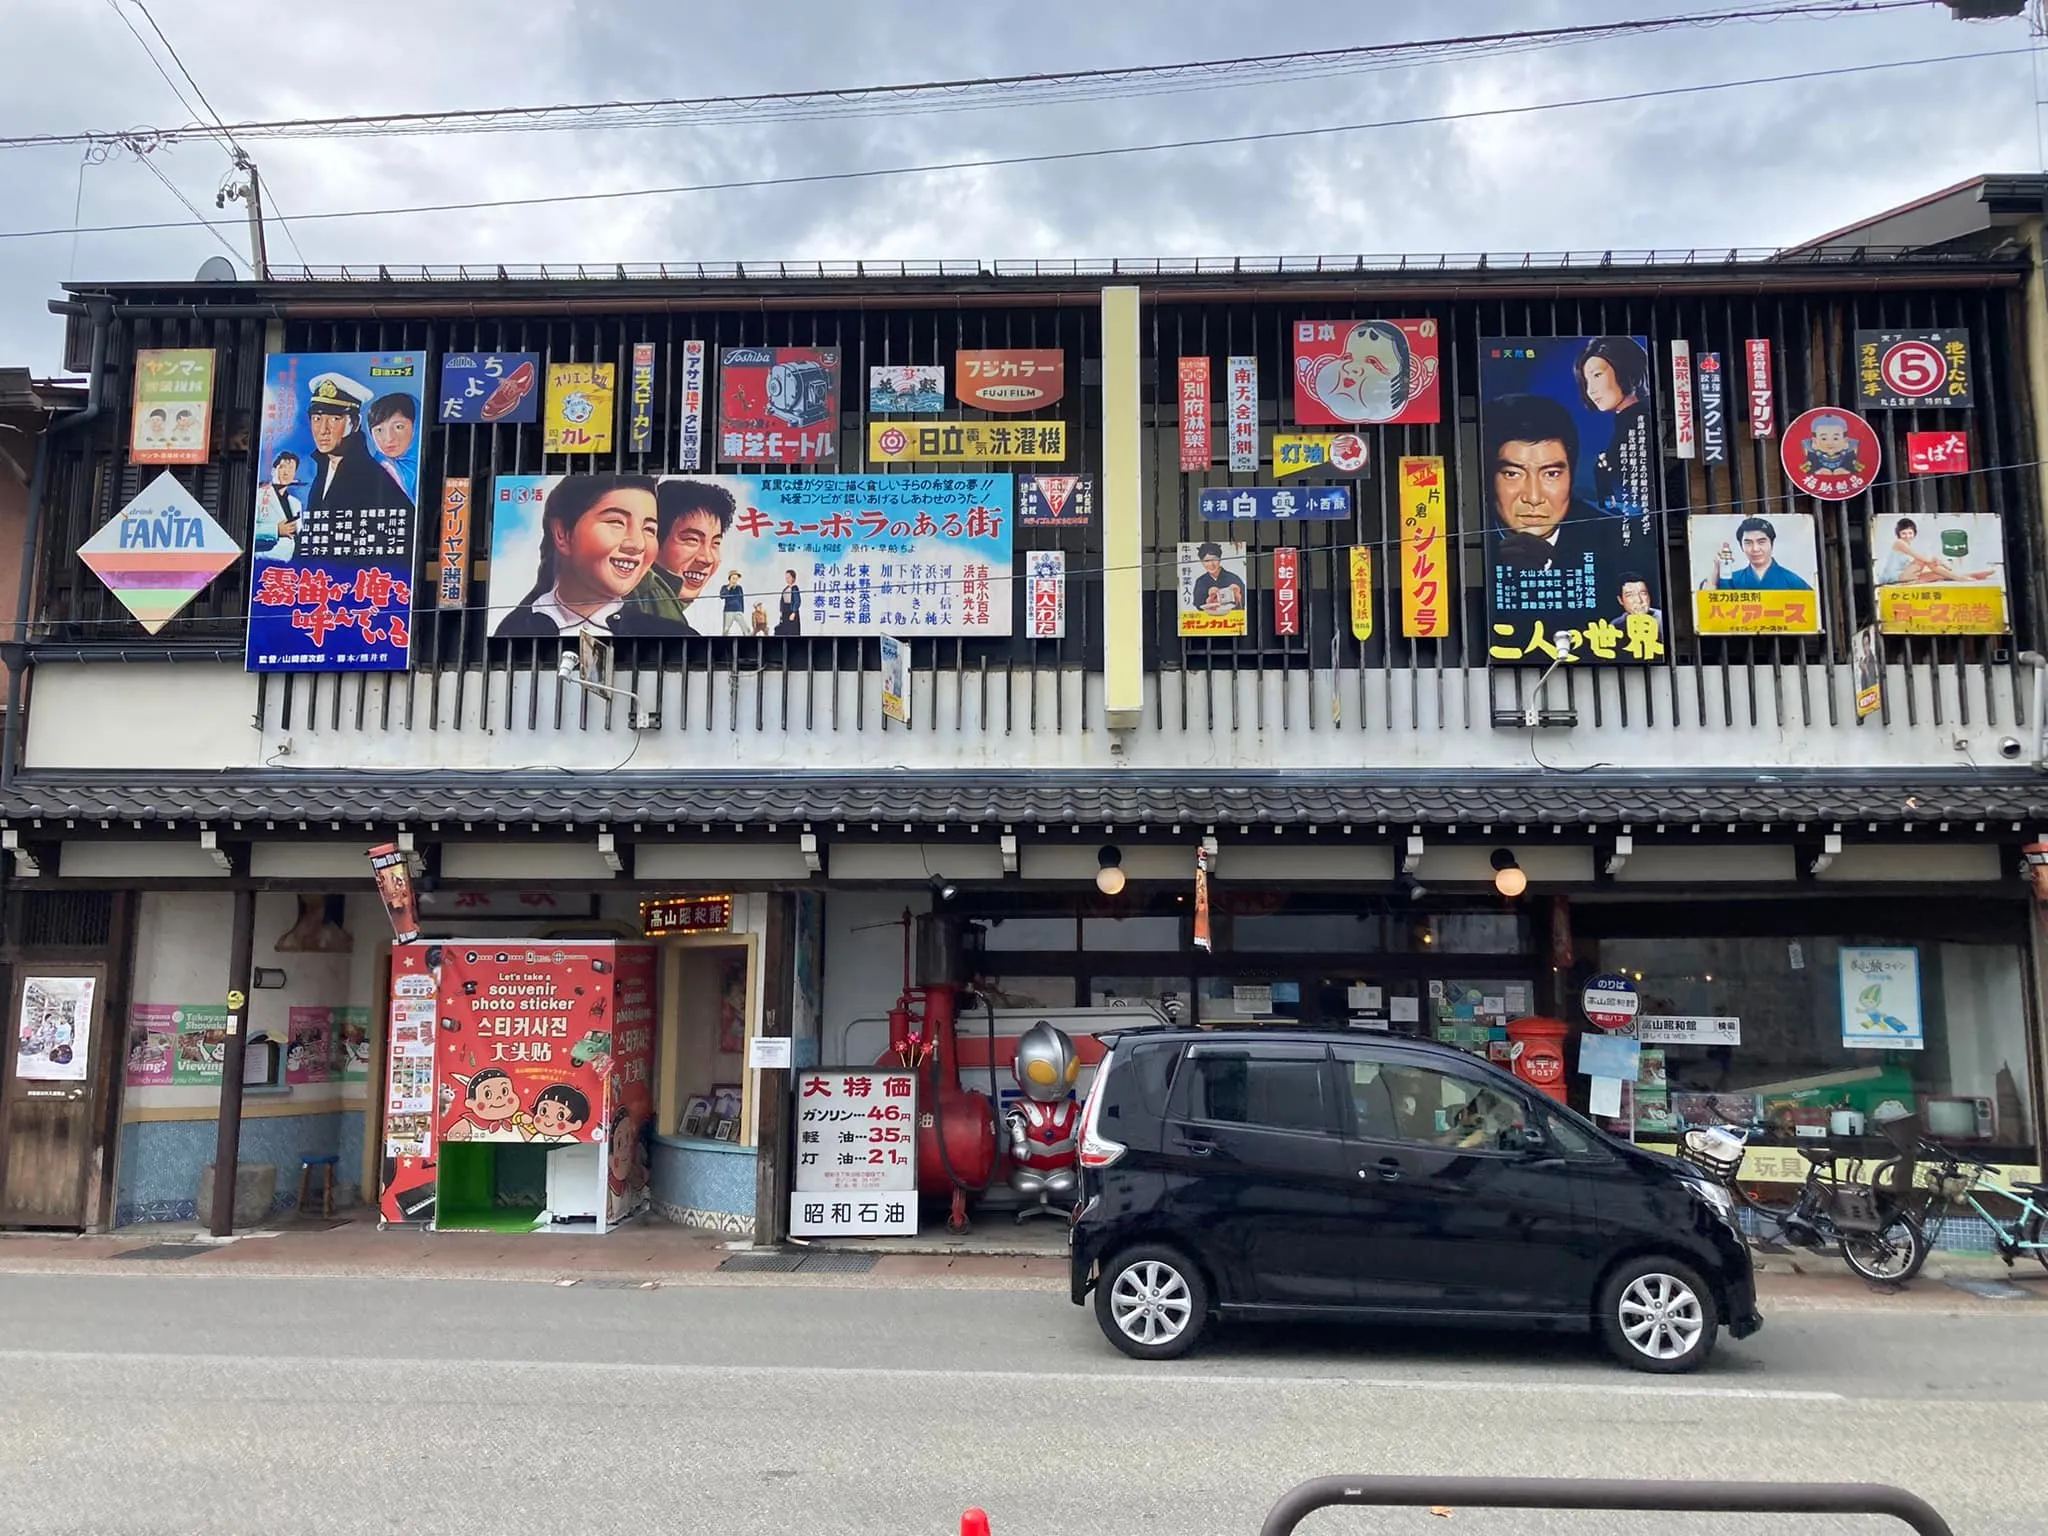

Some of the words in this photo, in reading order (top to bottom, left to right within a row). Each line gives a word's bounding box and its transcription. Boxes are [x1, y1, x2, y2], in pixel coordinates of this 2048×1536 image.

[1299, 324, 1335, 342] 日本
[1404, 320, 1435, 338] 一の
[723, 349, 770, 364] Toshiba
[145, 359, 204, 376] ヤンマー
[965, 361, 1054, 377] フジカラー
[1944, 341, 1968, 396] 地下たび
[982, 389, 1009, 397] FUJI
[1010, 389, 1036, 397] FILM
[1752, 390, 1772, 436] マリン
[561, 428, 606, 445] カレー
[724, 433, 834, 457] 東芝モートル
[1280, 443, 1324, 463] 灯油
[1203, 500, 1227, 512] 清酒
[1233, 491, 1299, 517] 白雪
[119, 505, 205, 548] FANTA
[735, 507, 1004, 538] キューポラのある街
[1583, 552, 1596, 609] 石原裕次郎
[963, 565, 974, 625] 浜田光夫
[977, 565, 989, 624] 吉永小百合
[1279, 567, 1294, 633] 蛇ノ目ソース
[1708, 592, 1760, 602] 強力殺虫剤
[1036, 580, 1056, 634] 美人わた
[1710, 603, 1806, 624] ハイアース
[1183, 620, 1244, 634] ボンカレー
[651, 906, 721, 927] 高山昭和館
[499, 973, 521, 981] Let's
[523, 973, 543, 981] take
[1598, 980, 1625, 989] のりば
[489, 983, 557, 1000] souvenir
[471, 998, 515, 1010] photo
[520, 998, 575, 1010] sticker
[478, 1017, 567, 1036] 스티커사진
[490, 1042, 552, 1061] 大头贴
[804, 1077, 911, 1097] 大特価
[1755, 1157, 1803, 1177] 玩具
[806, 1203, 904, 1223] 昭和石油
